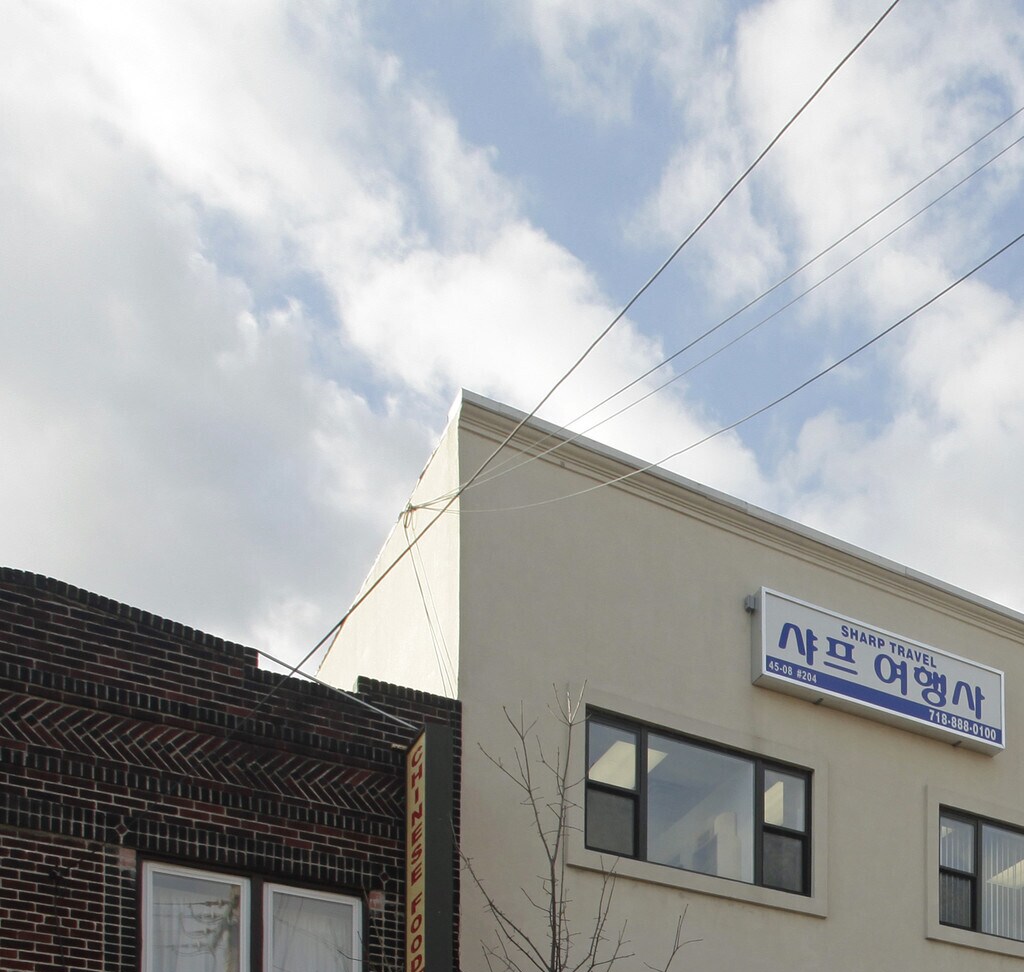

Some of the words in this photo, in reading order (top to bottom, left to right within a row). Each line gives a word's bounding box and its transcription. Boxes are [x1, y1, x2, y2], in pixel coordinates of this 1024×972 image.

[841, 624, 885, 649] SHARP
[889, 641, 937, 669] TRAVEL
[768, 659, 793, 676] 45-08
[796, 669, 817, 684] #204
[778, 622, 859, 675] 샤프
[873, 653, 985, 720] 여행사
[928, 708, 997, 741] 718-888-0100
[411, 745, 423, 887] CHINESE
